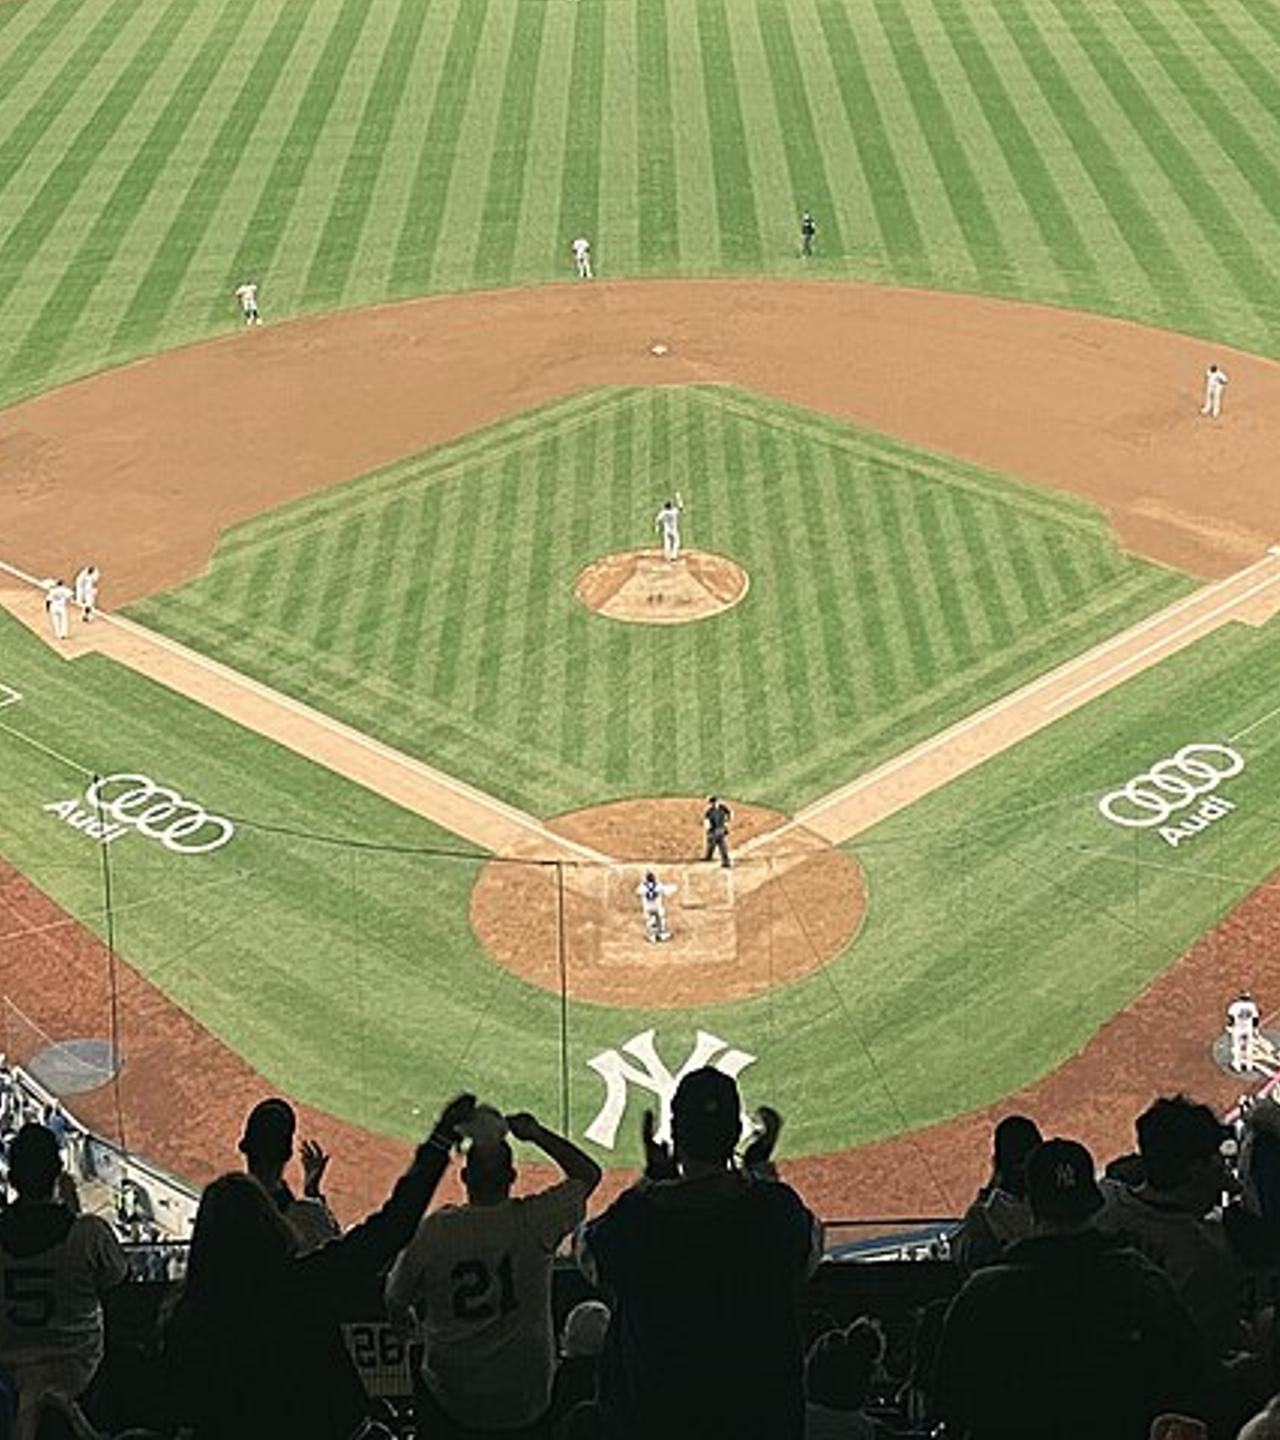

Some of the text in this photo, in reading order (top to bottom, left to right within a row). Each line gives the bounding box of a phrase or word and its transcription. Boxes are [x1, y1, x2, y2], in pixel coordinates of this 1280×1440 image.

[42, 798, 129, 846] Audi
[1156, 794, 1239, 849] Audi
[583, 1027, 760, 1154] NY
[3, 1268, 58, 1328] 5
[451, 1252, 519, 1319] 21
